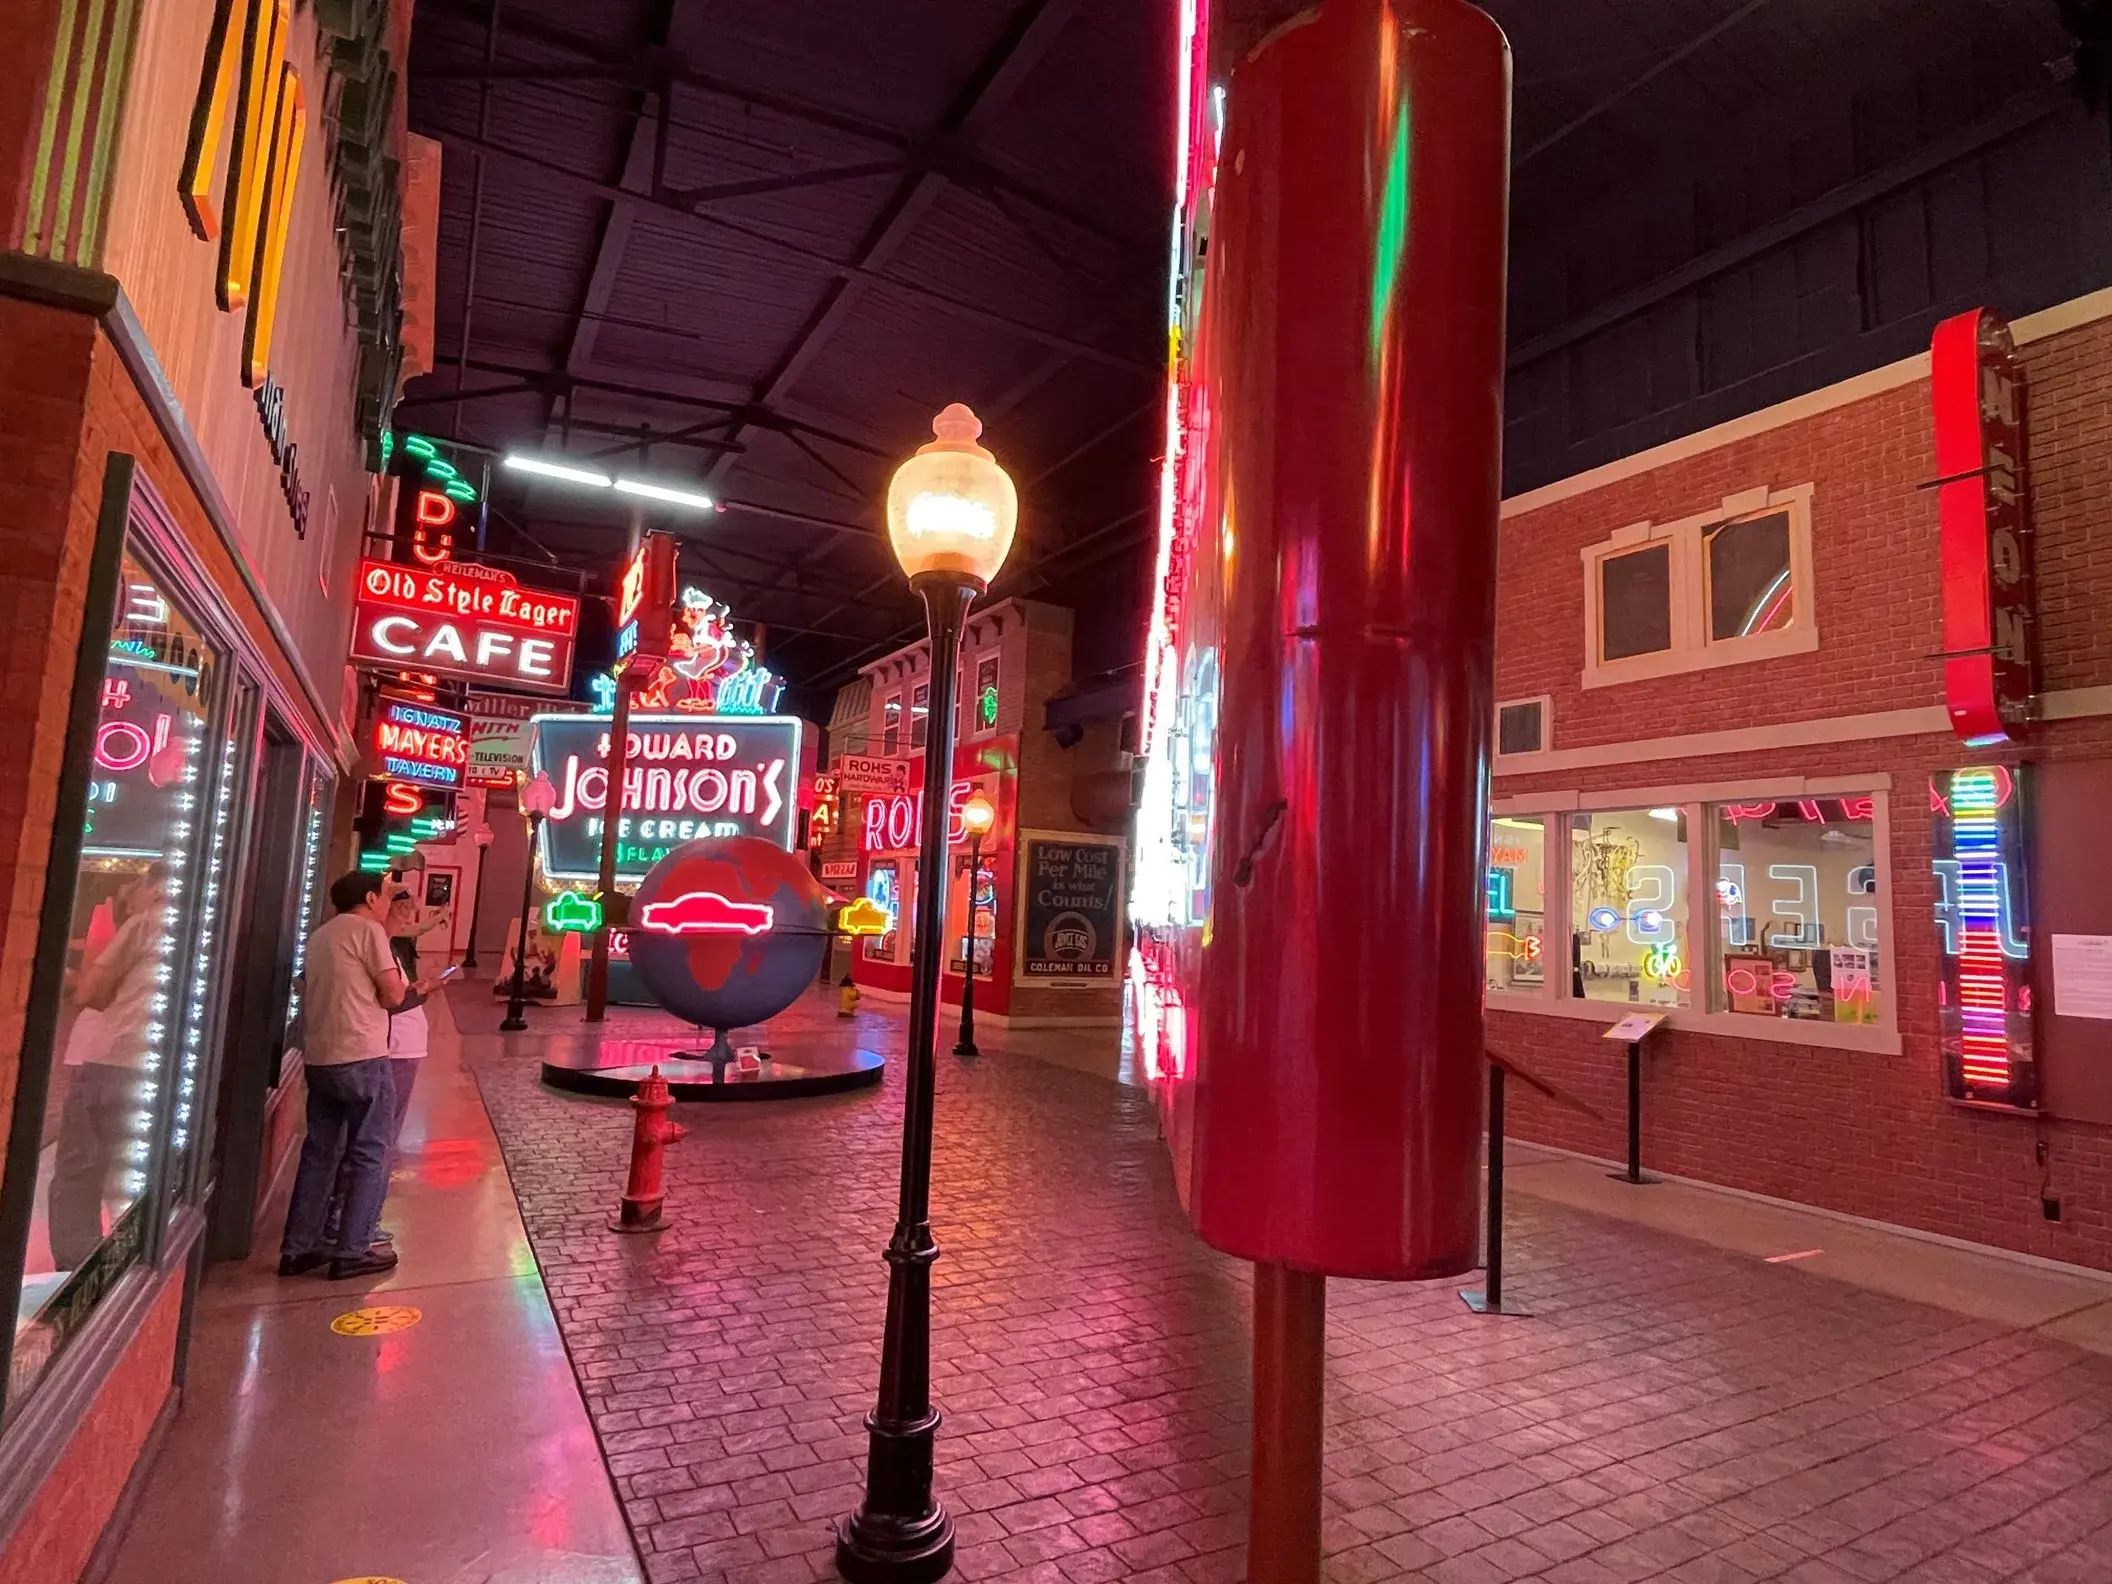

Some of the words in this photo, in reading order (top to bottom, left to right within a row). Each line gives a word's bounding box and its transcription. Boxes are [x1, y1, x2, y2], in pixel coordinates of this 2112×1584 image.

[366, 568, 416, 600] Old
[422, 578, 493, 615] Style
[499, 589, 572, 627] Lager
[371, 616, 555, 676] CAFE
[390, 704, 462, 734] IGNATZ
[471, 721, 519, 735] NITH
[380, 722, 469, 765] MAYER'S
[386, 756, 457, 783] TAVERN
[849, 760, 892, 775] ROHS
[865, 780, 972, 851] ROS
[1038, 846, 1073, 861] Low
[1075, 847, 1108, 865] Cost
[1038, 860, 1068, 876] Per
[1072, 862, 1107, 880] Mile
[1038, 884, 1114, 911] Counts!
[1030, 962, 1073, 973] COLEMAN
[1077, 963, 1092, 973] OIL
[1095, 964, 1108, 973] CO
